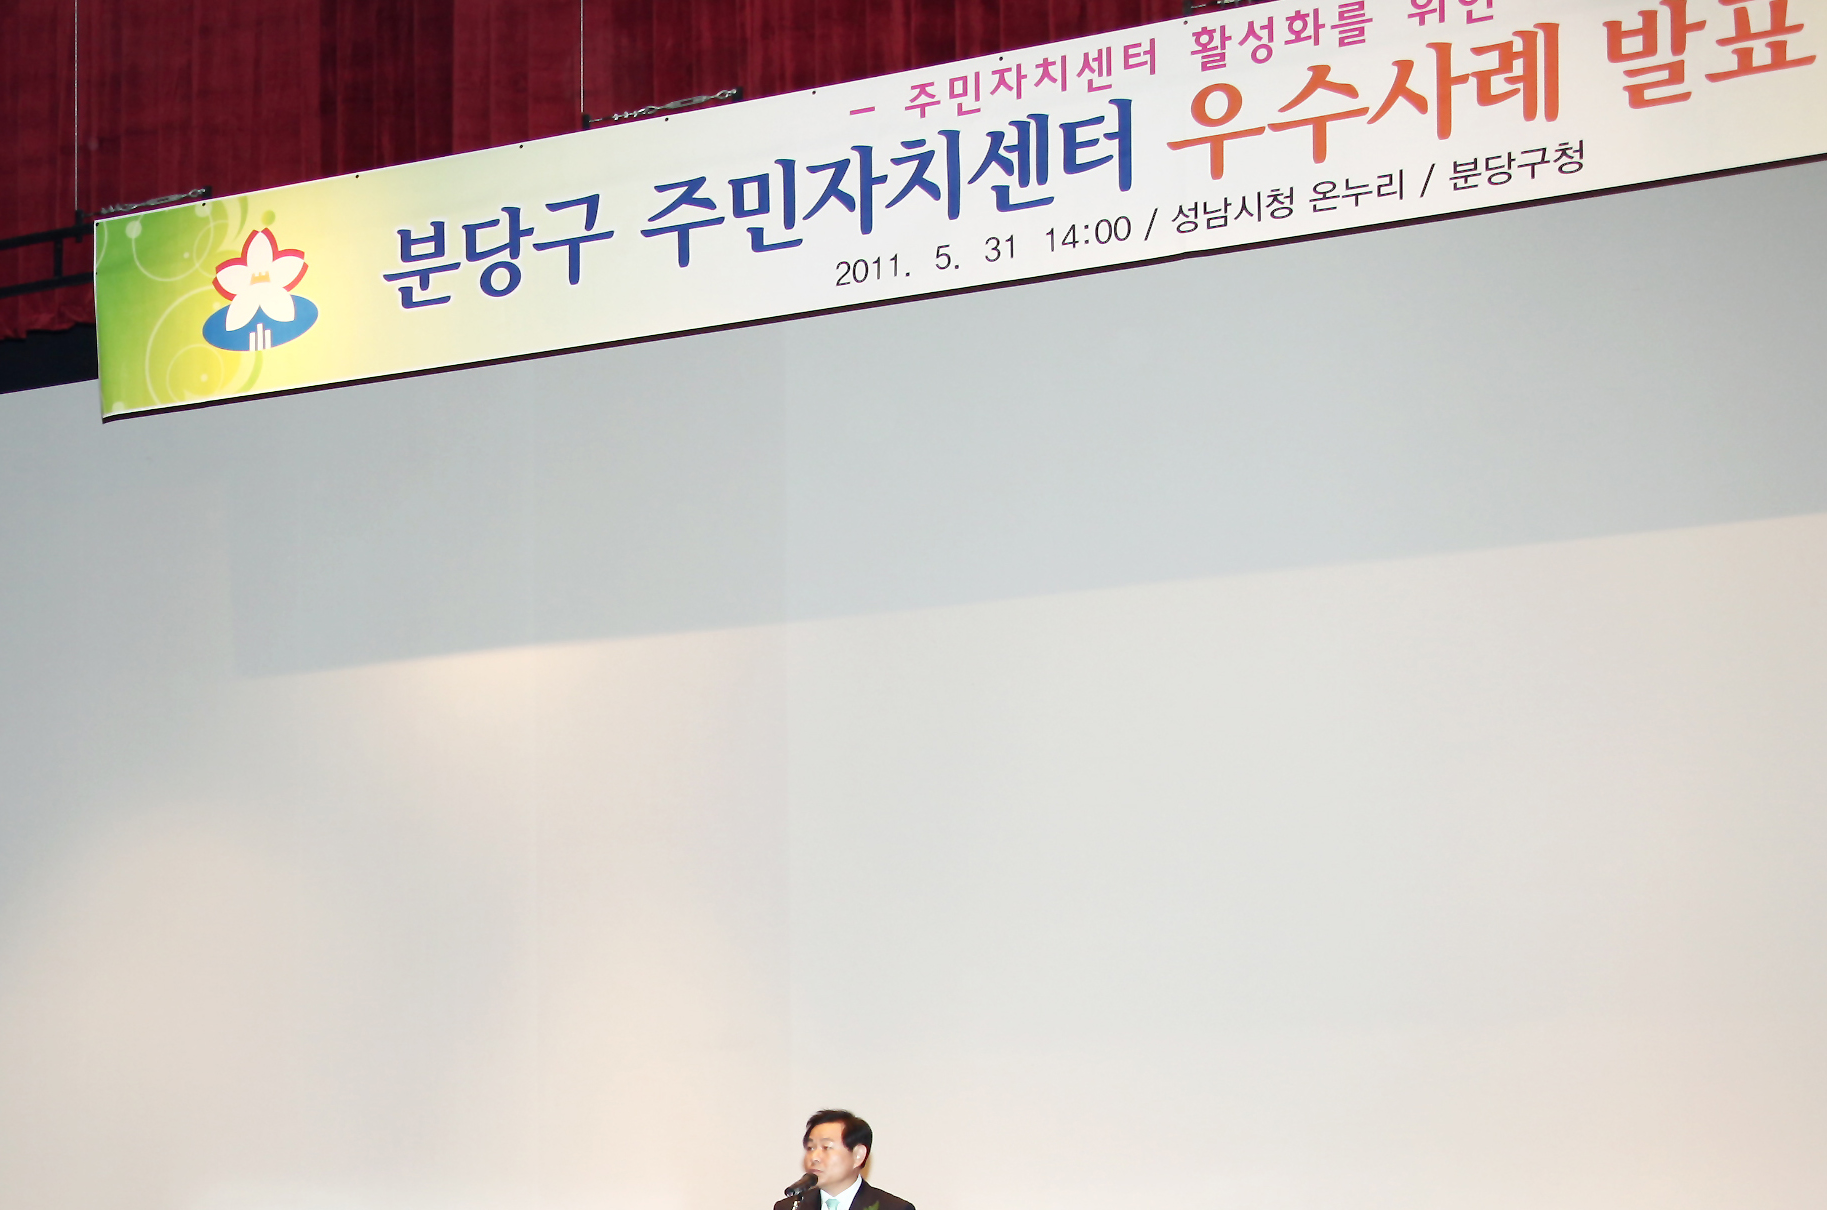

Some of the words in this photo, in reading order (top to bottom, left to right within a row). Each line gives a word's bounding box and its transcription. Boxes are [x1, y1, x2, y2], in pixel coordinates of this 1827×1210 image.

[904, 37, 1157, 119] 주민자치센터
[1189, 0, 1374, 72] 활성화를
[382, 193, 615, 310] 분당구
[640, 98, 1134, 268] 주민자치센터
[1166, 22, 1561, 181] 우수사례
[1602, 0, 1817, 109] 발표
[835, 254, 911, 287] 2011.
[934, 245, 961, 271] 5.
[984, 234, 1016, 263] 31
[1045, 215, 1132, 252] 14:00
[1171, 186, 1295, 234] 성남시청
[1308, 169, 1405, 213] 온누리
[1448, 139, 1586, 192] 분당구청
